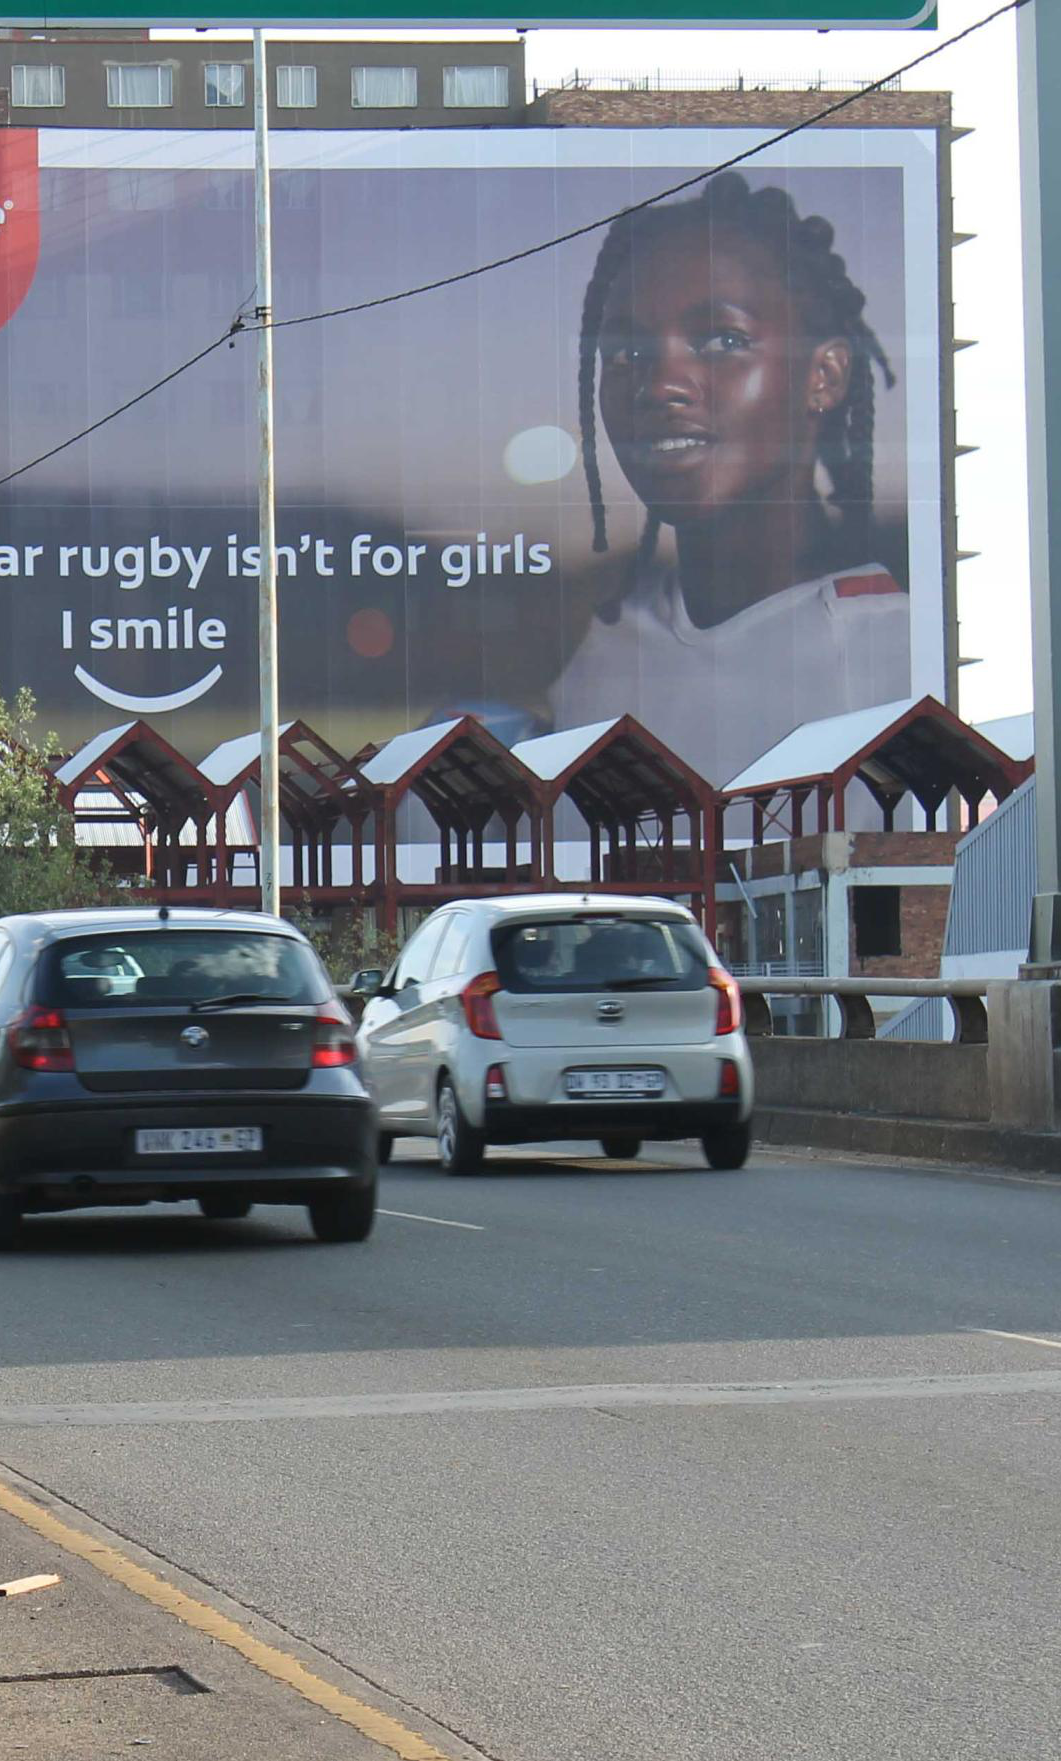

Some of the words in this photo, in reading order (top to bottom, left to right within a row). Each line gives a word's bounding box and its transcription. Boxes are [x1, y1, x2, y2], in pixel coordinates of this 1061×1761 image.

[59, 535, 212, 589] rugby
[227, 533, 334, 577] isn't
[351, 534, 426, 576] for
[441, 531, 552, 588] girls
[62, 610, 72, 649] I
[90, 606, 227, 650] smile
